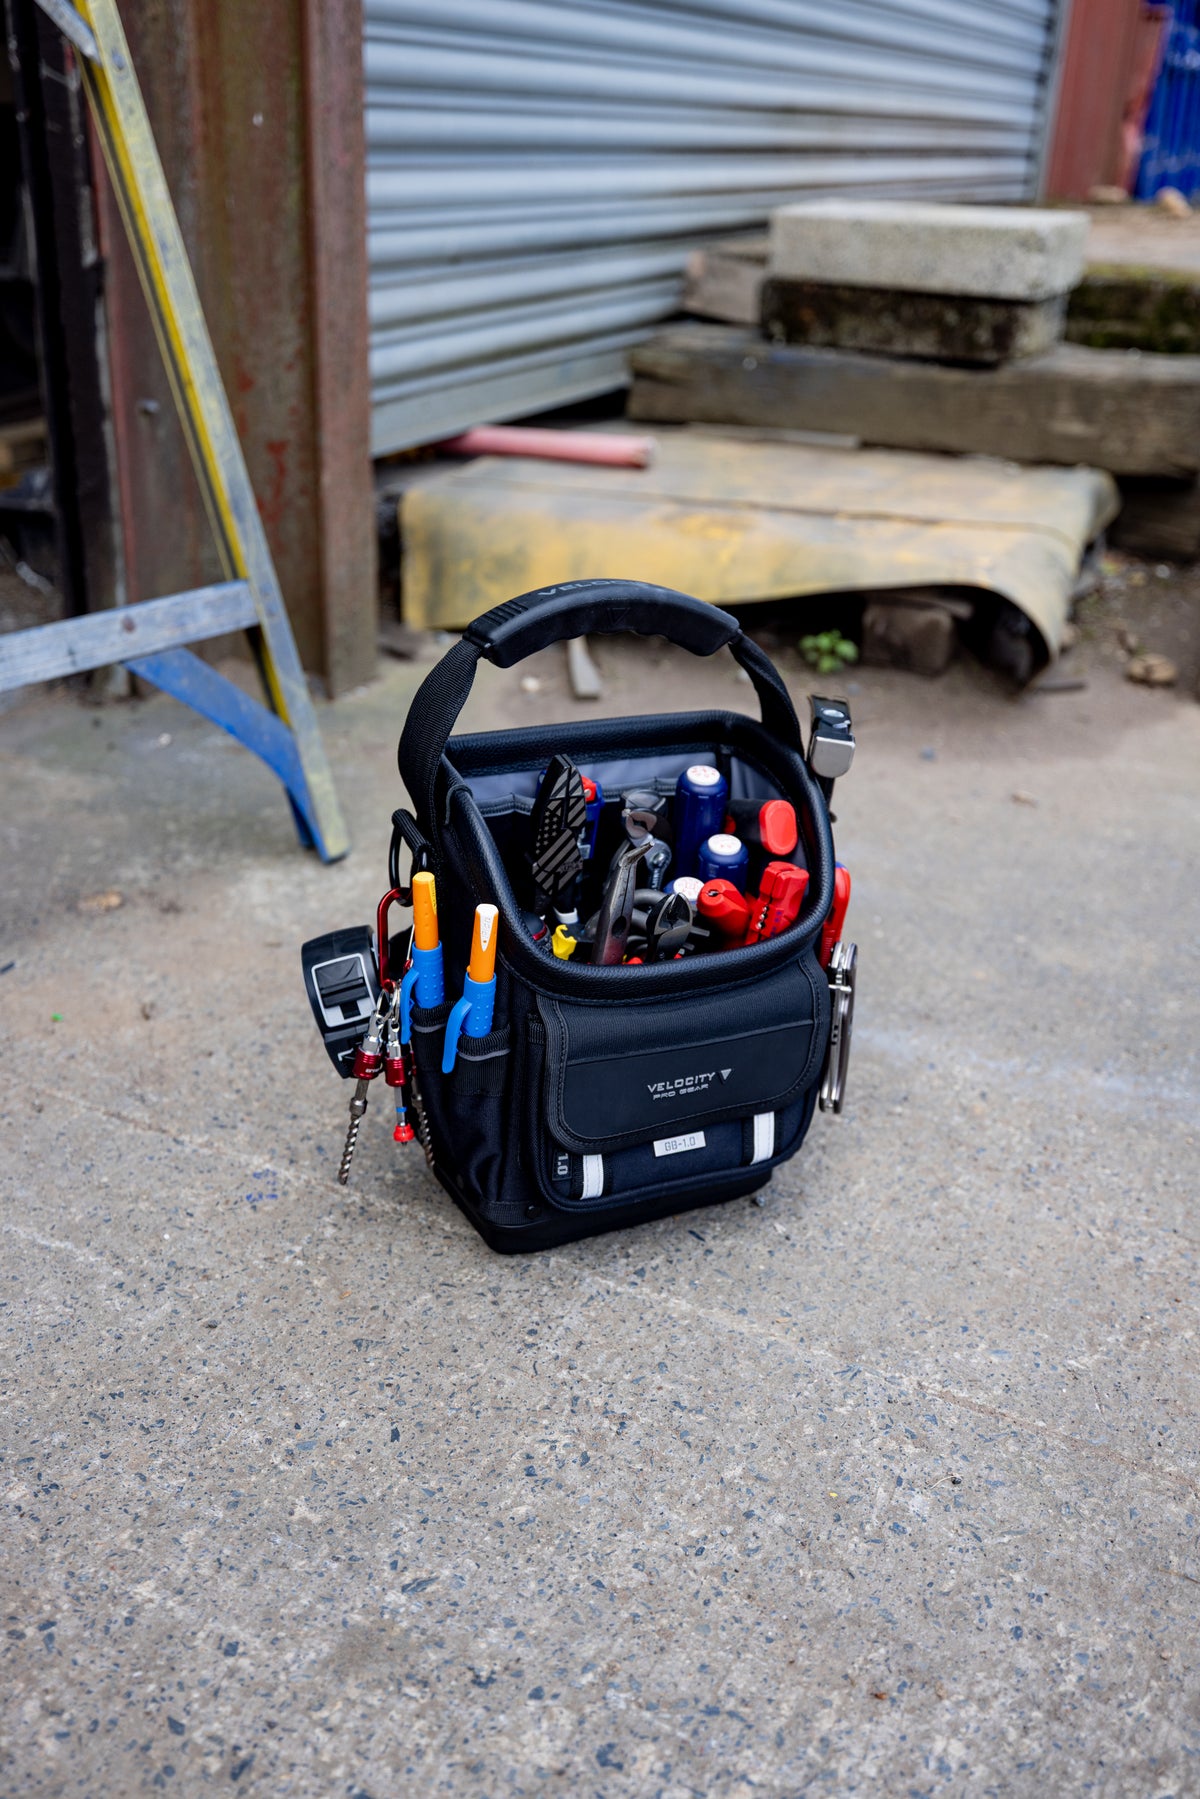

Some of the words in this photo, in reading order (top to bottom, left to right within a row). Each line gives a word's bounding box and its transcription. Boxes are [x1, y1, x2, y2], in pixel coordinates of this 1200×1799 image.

[647, 1072, 716, 1093] VELOCITY
[653, 1091, 676, 1100] PRO
[679, 1083, 709, 1095] GEAR
